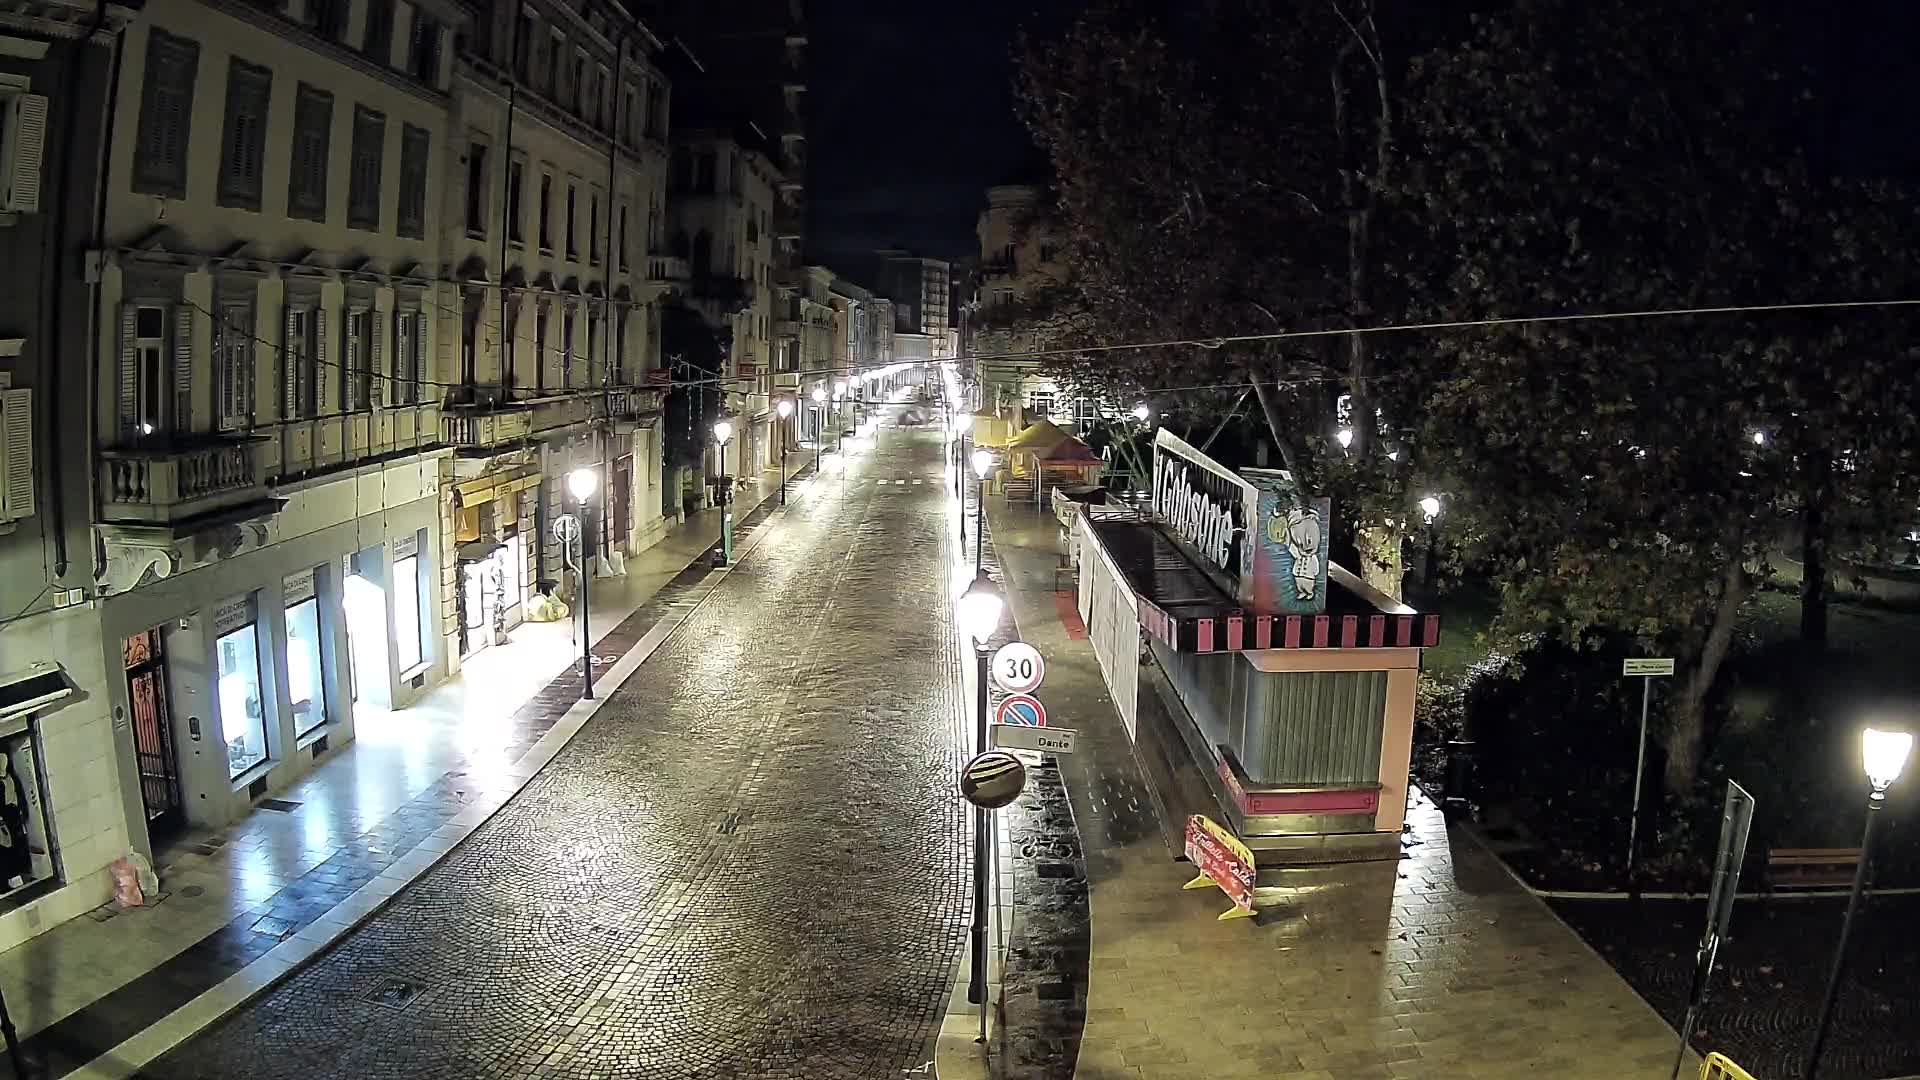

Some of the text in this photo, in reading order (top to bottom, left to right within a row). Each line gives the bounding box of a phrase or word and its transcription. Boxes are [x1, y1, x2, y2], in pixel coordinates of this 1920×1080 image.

[1162, 457, 1234, 570] Golosone
[1006, 658, 1032, 680] 30
[1038, 737, 1070, 749] Dante
